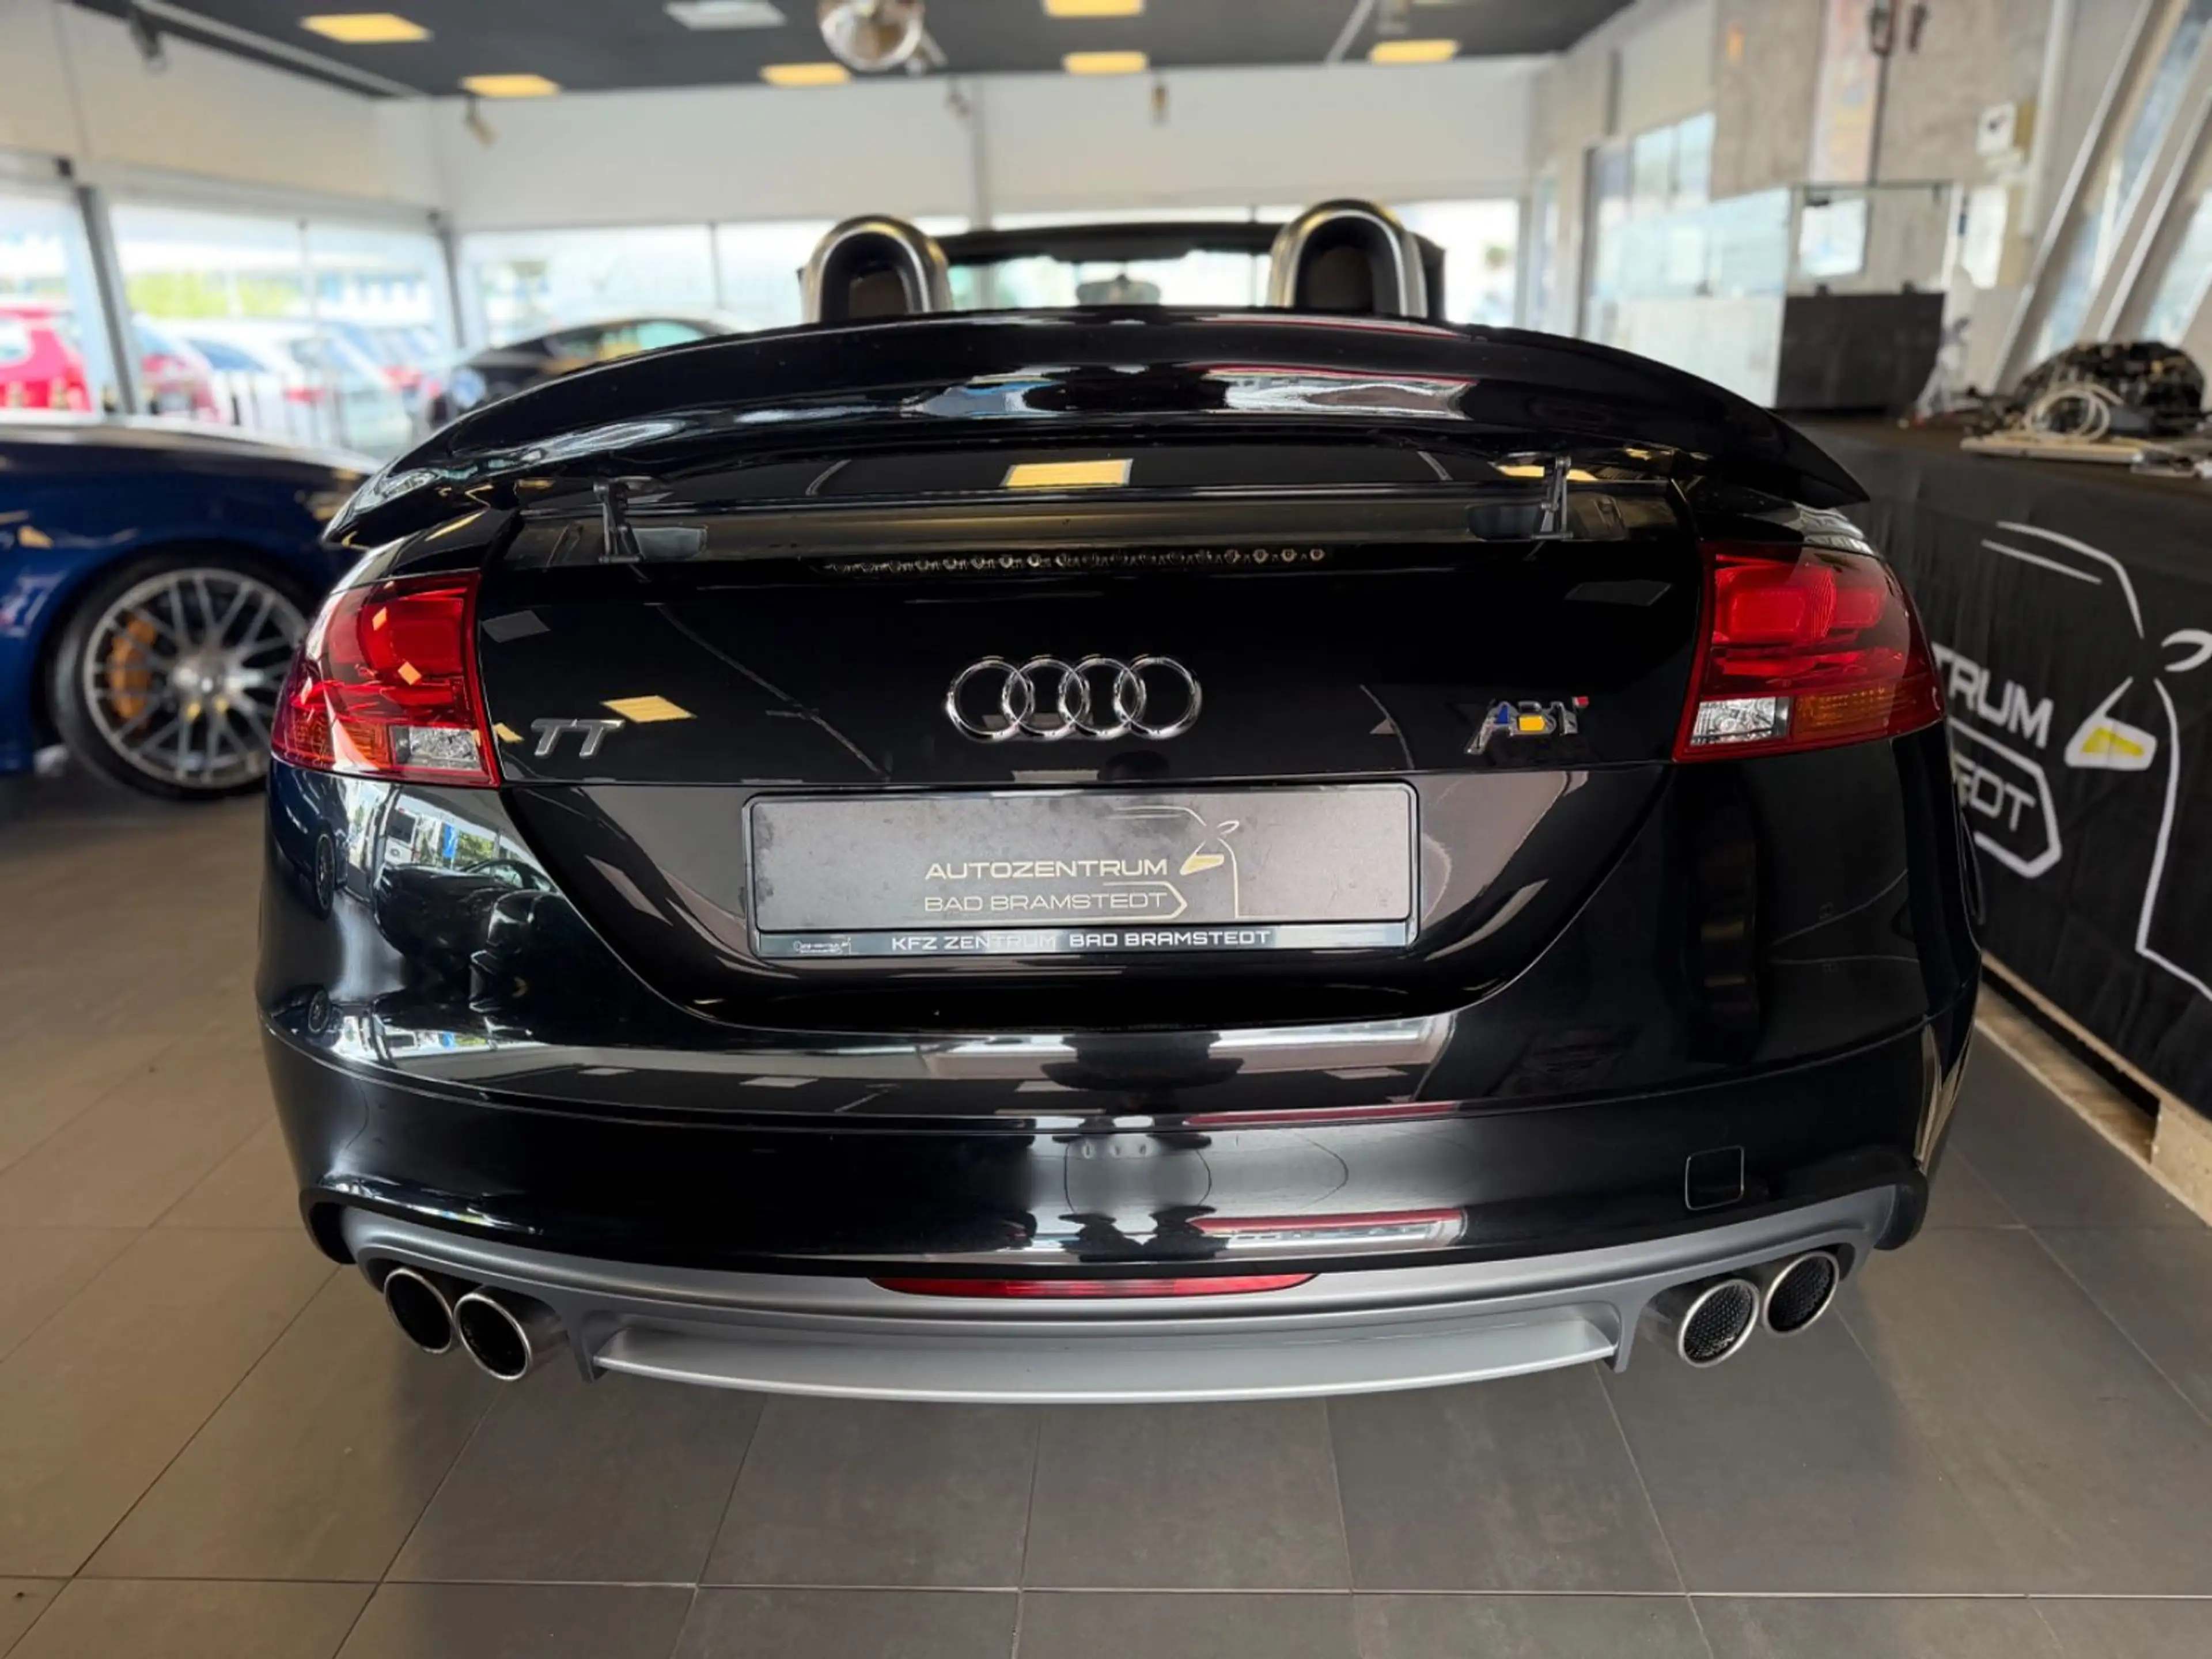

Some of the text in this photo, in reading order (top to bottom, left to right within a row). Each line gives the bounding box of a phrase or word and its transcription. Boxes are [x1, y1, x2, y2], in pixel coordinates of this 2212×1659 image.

[531, 718, 626, 759] TT
[925, 859, 1168, 880] AUTOZENTRUM
[925, 891, 1168, 912] BAD BRAMSTEDT
[892, 930, 1271, 950] KFZ ZENTRUM BAD BRAMSTEDT
